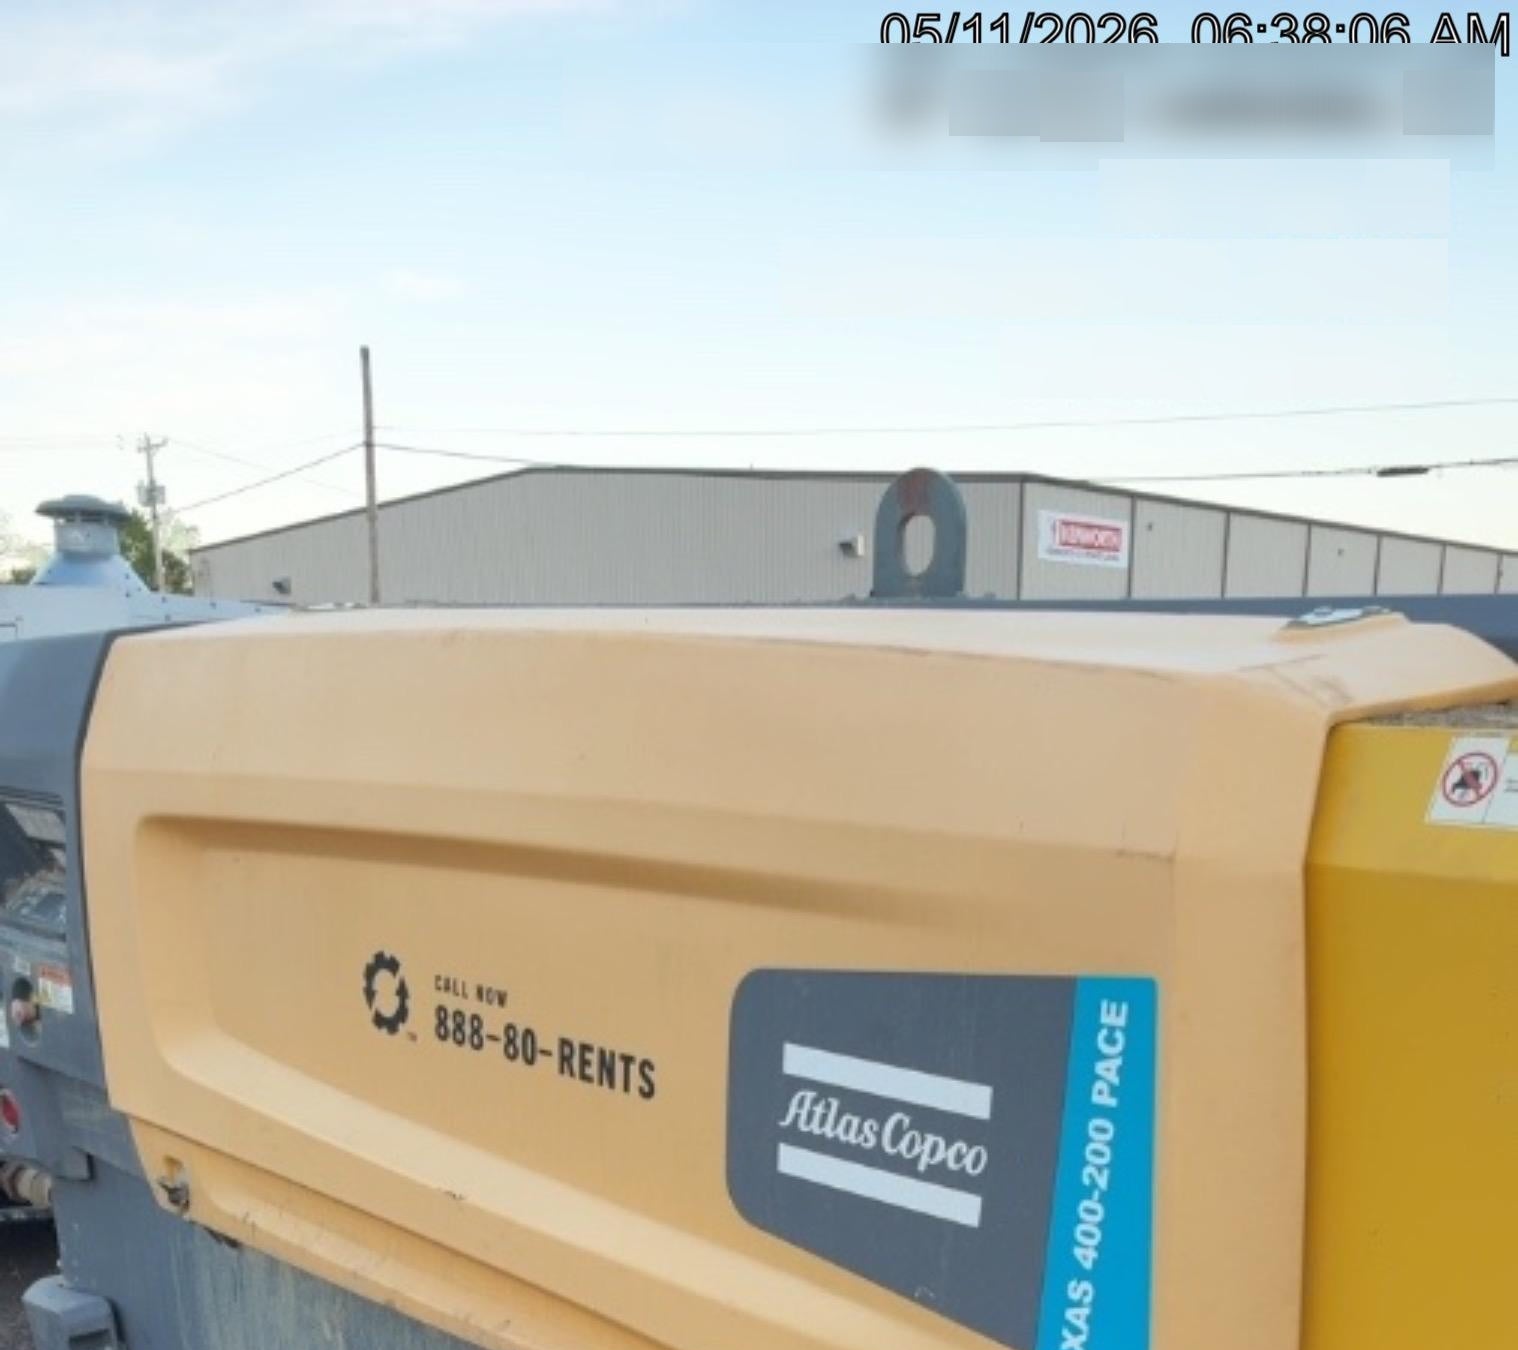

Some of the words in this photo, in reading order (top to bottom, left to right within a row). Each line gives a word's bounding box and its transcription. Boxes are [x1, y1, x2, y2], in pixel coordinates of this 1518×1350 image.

[434, 974, 469, 1000] CALL
[476, 984, 508, 1008] NOW
[434, 1004, 656, 1100] 888-80-RENTS
[1091, 999, 1128, 1107] PACE
[779, 1090, 879, 1149] Atlas
[881, 1112, 988, 1177] Copco
[1074, 1118, 1115, 1270] 400-200
